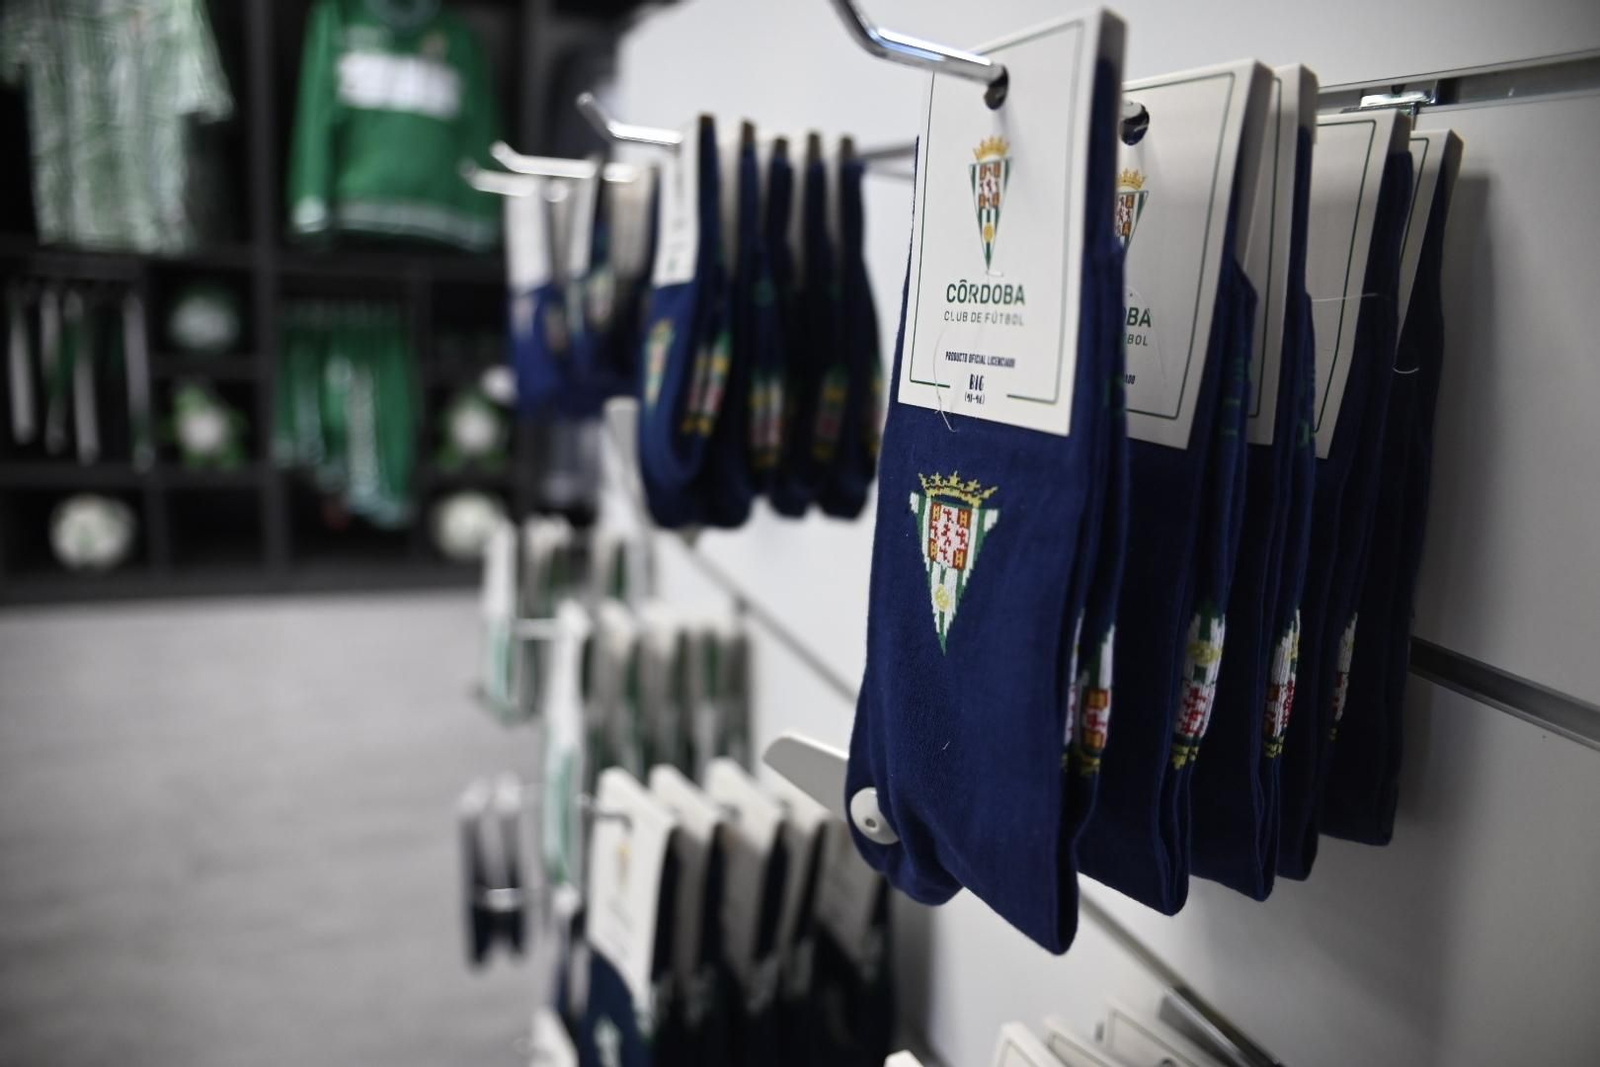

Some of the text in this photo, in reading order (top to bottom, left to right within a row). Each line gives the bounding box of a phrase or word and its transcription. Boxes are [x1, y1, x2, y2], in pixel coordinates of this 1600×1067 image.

[944, 310, 1024, 326] CLUB DE FÚTBOL
[945, 351, 968, 363] PRODUCTO
[968, 353, 986, 365] OFICIAL
[968, 373, 984, 391] BIG
